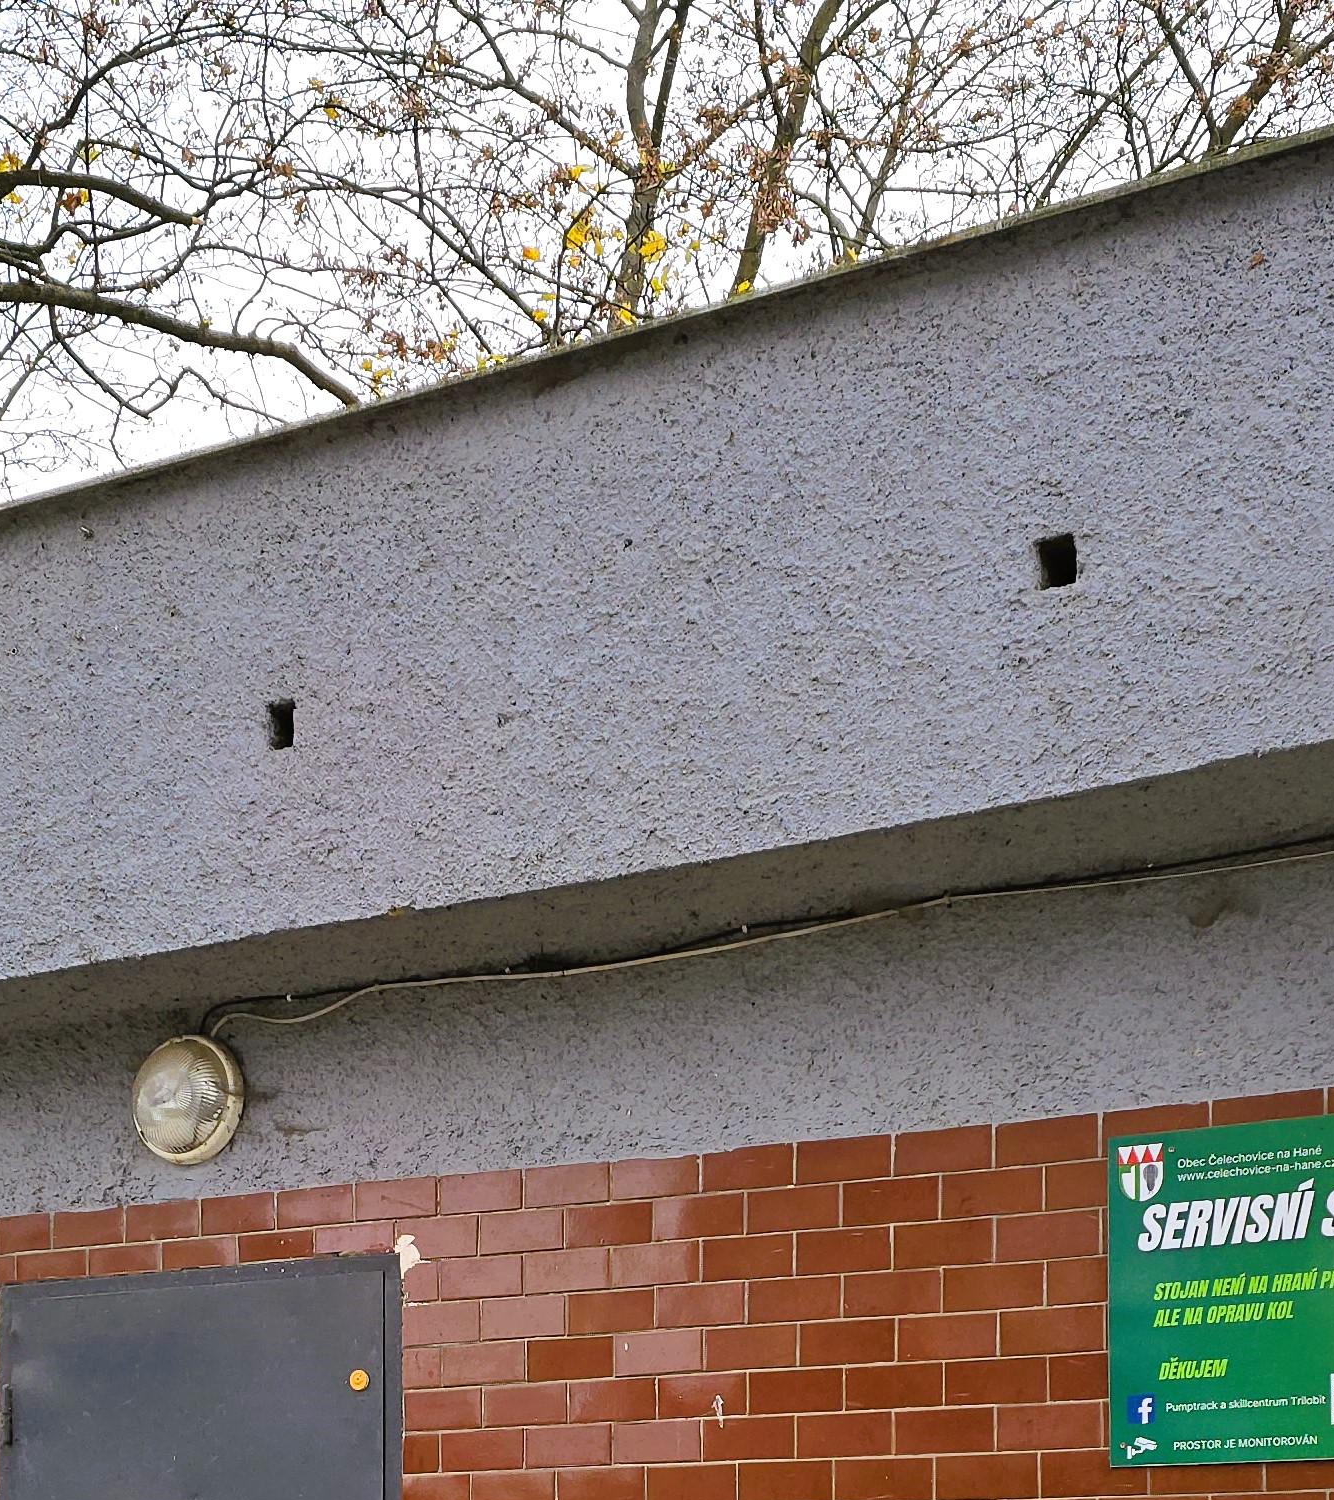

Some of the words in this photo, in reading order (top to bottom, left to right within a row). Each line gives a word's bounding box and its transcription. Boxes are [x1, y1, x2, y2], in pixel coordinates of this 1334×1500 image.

[1177, 1156, 1206, 1169] Obec
[1208, 1152, 1274, 1167] Čelechovice
[1276, 1150, 1291, 1159] na
[1293, 1144, 1323, 1158] Hané
[1137, 1177, 1315, 1252] SERVISNÍ
[1153, 1279, 1209, 1301] STOJAN
[1211, 1272, 1246, 1297] NENÍ
[1247, 1275, 1268, 1295] NA
[1271, 1267, 1318, 1293] HRANÍ
[1153, 1308, 1181, 1328] ALE
[1182, 1306, 1202, 1326] NA
[1206, 1302, 1265, 1324] OPRAVU
[1266, 1300, 1295, 1320] KOL
[1158, 1356, 1228, 1381] DĚKUJEM
[1165, 1400, 1218, 1413] Pumptrack
[1219, 1401, 1227, 1410] a
[1228, 1397, 1289, 1409] skillcentrum
[1290, 1395, 1327, 1406] Trilobit
[1173, 1439, 1222, 1451] PROSTOR
[1223, 1438, 1237, 1449] JE
[1238, 1434, 1319, 1448] MONITOROVÁN
